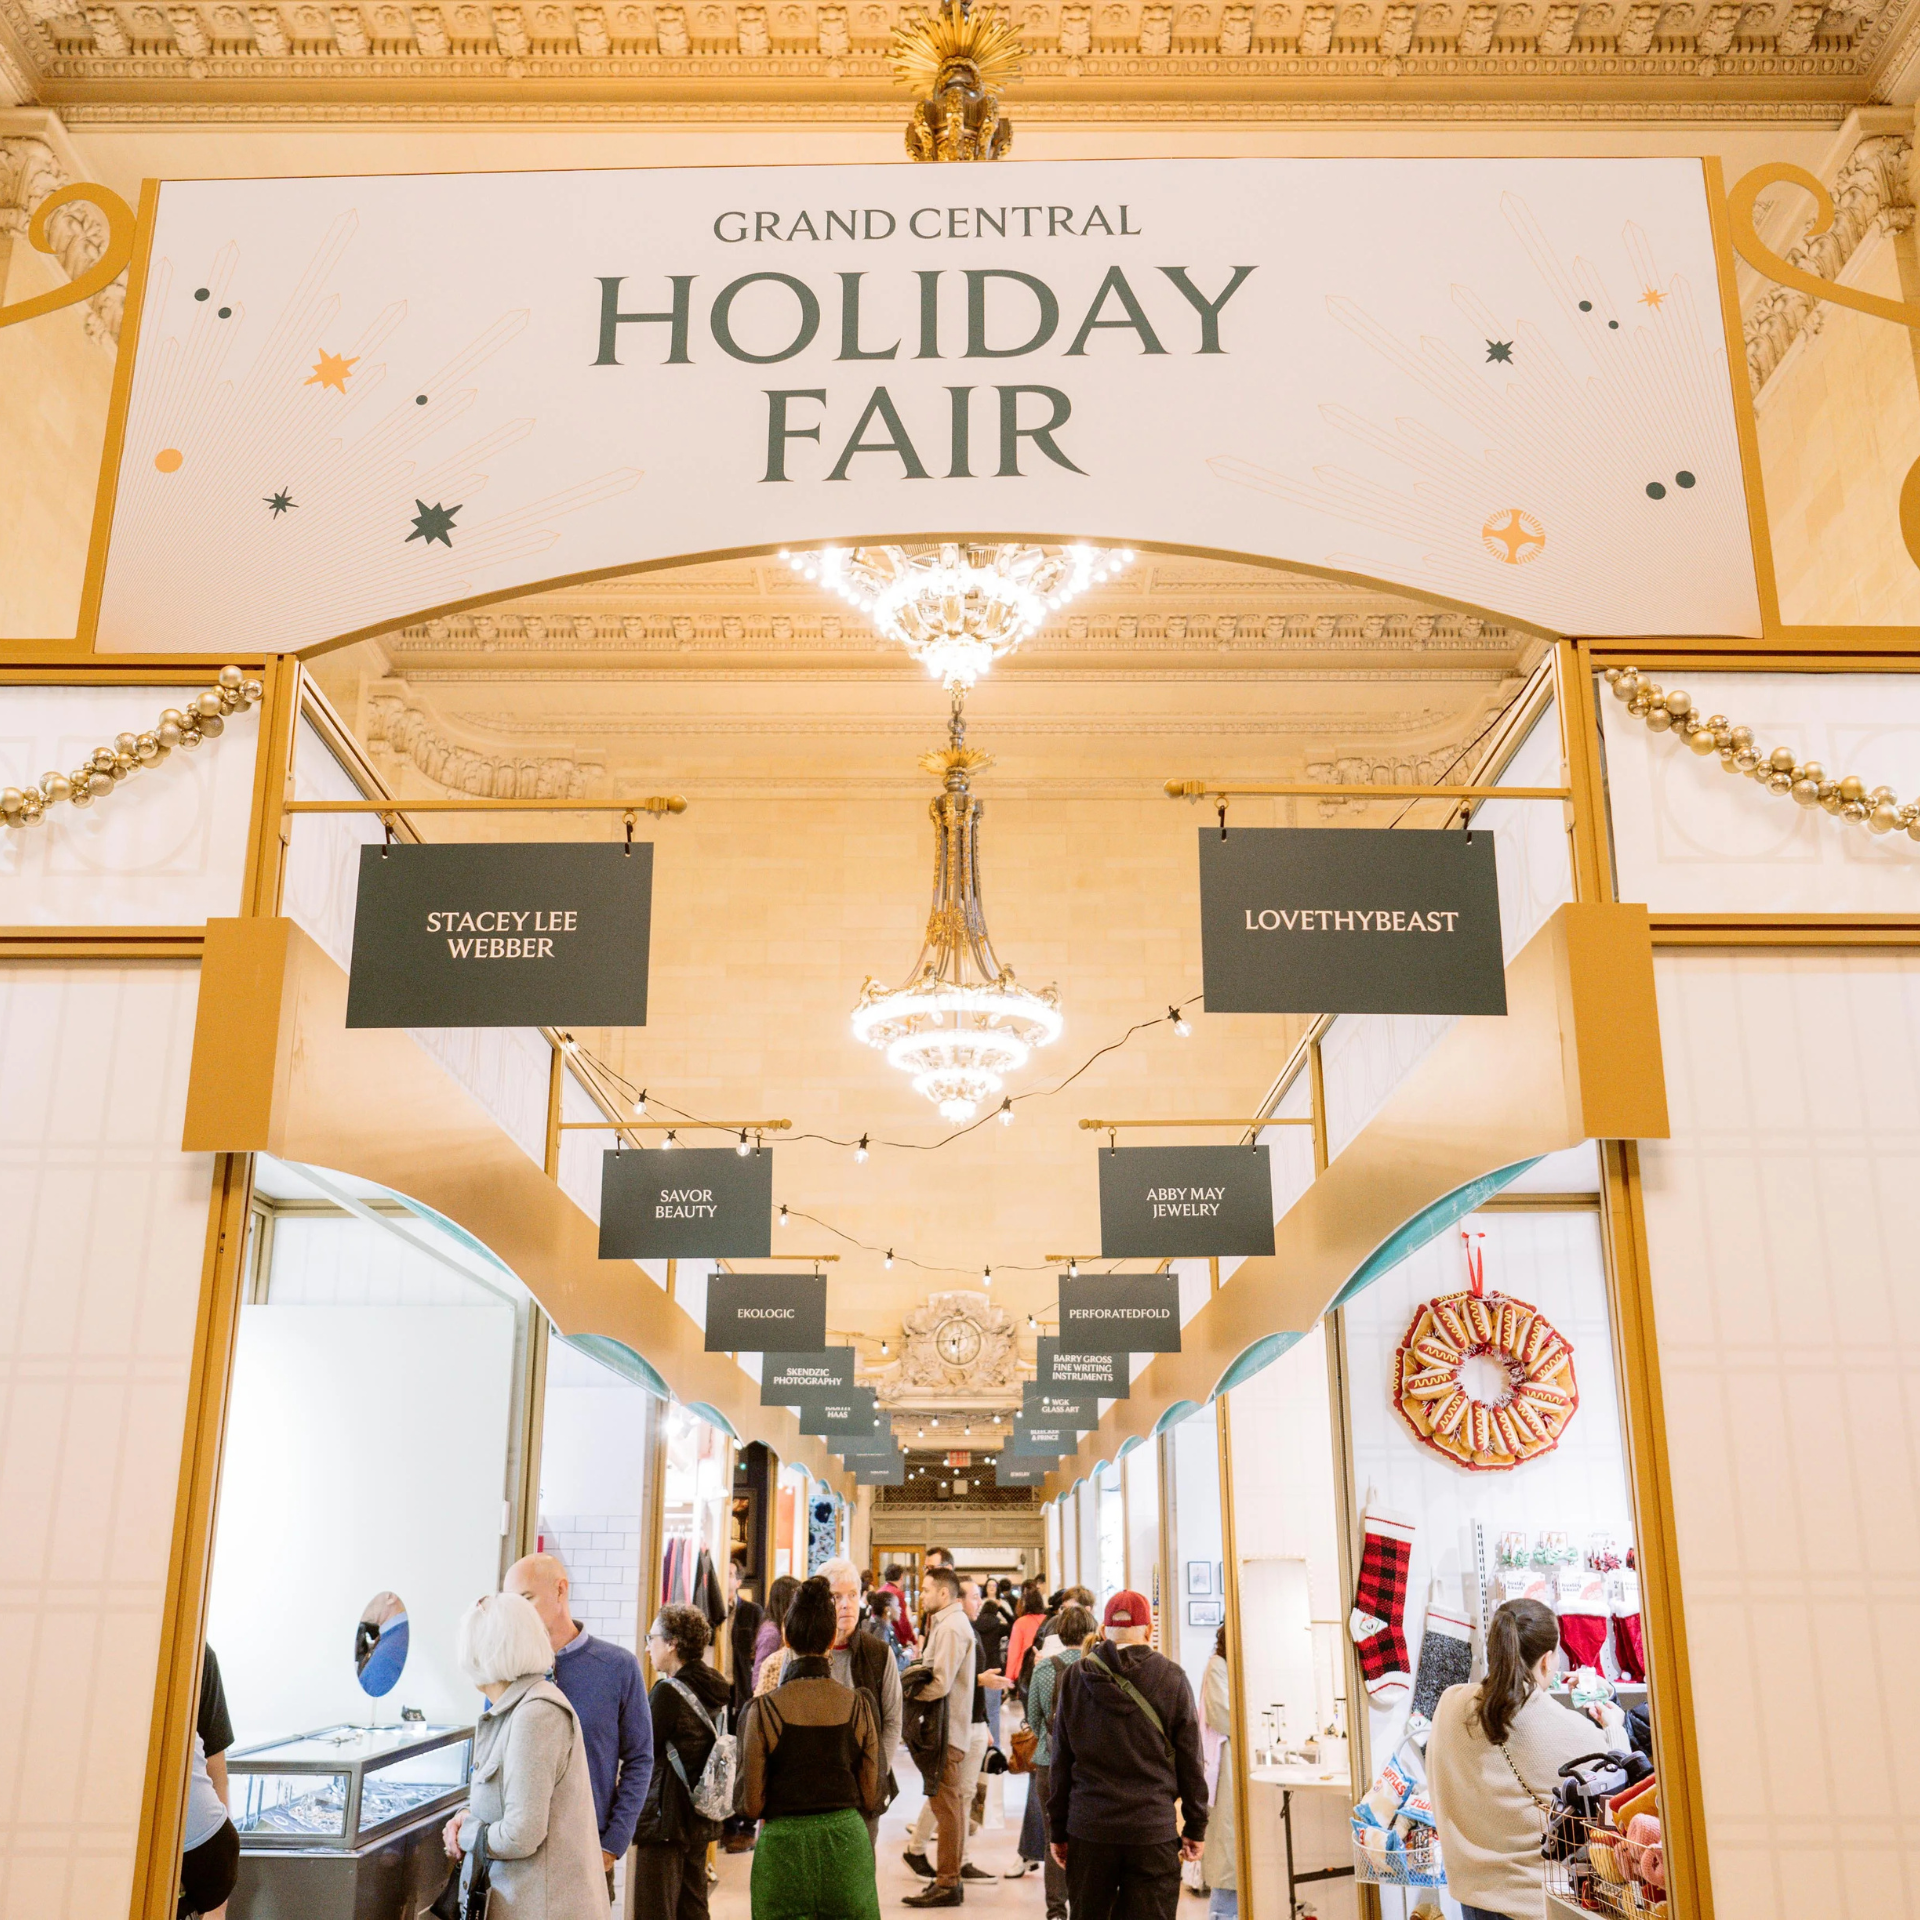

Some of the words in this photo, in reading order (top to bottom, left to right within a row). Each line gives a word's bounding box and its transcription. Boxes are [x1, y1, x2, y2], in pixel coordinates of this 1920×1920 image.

[712, 208, 897, 243] GRAND
[908, 204, 1143, 239] CENTRAL
[588, 265, 1260, 367] HOLIDAY
[757, 384, 1091, 483] FAIR
[426, 911, 530, 933] STACEY
[534, 911, 578, 932] LEE
[1244, 909, 1459, 932] LOVETHYBEAST
[447, 937, 556, 959] WEBBER
[660, 1189, 713, 1203] SAVOR
[1146, 1187, 1187, 1201] ABBY
[1190, 1187, 1226, 1200] MAY
[655, 1205, 718, 1218] BEAUTY
[1153, 1203, 1220, 1219] JEWELRY
[737, 1308, 795, 1319] EKOLOGIC
[1069, 1308, 1171, 1319] PERFORATEDFOLD
[1053, 1354, 1082, 1363] BARRY
[1083, 1355, 1112, 1364] GROSS
[786, 1367, 830, 1377] SKENDZIC
[1053, 1363, 1072, 1372] FINE
[1073, 1364, 1112, 1373] WRITING
[773, 1376, 842, 1385] PHOTOGRAPHY
[1052, 1372, 1114, 1381] INSTRUMENTS
[1041, 1405, 1065, 1413] GLASS
[1065, 1405, 1080, 1413] ART
